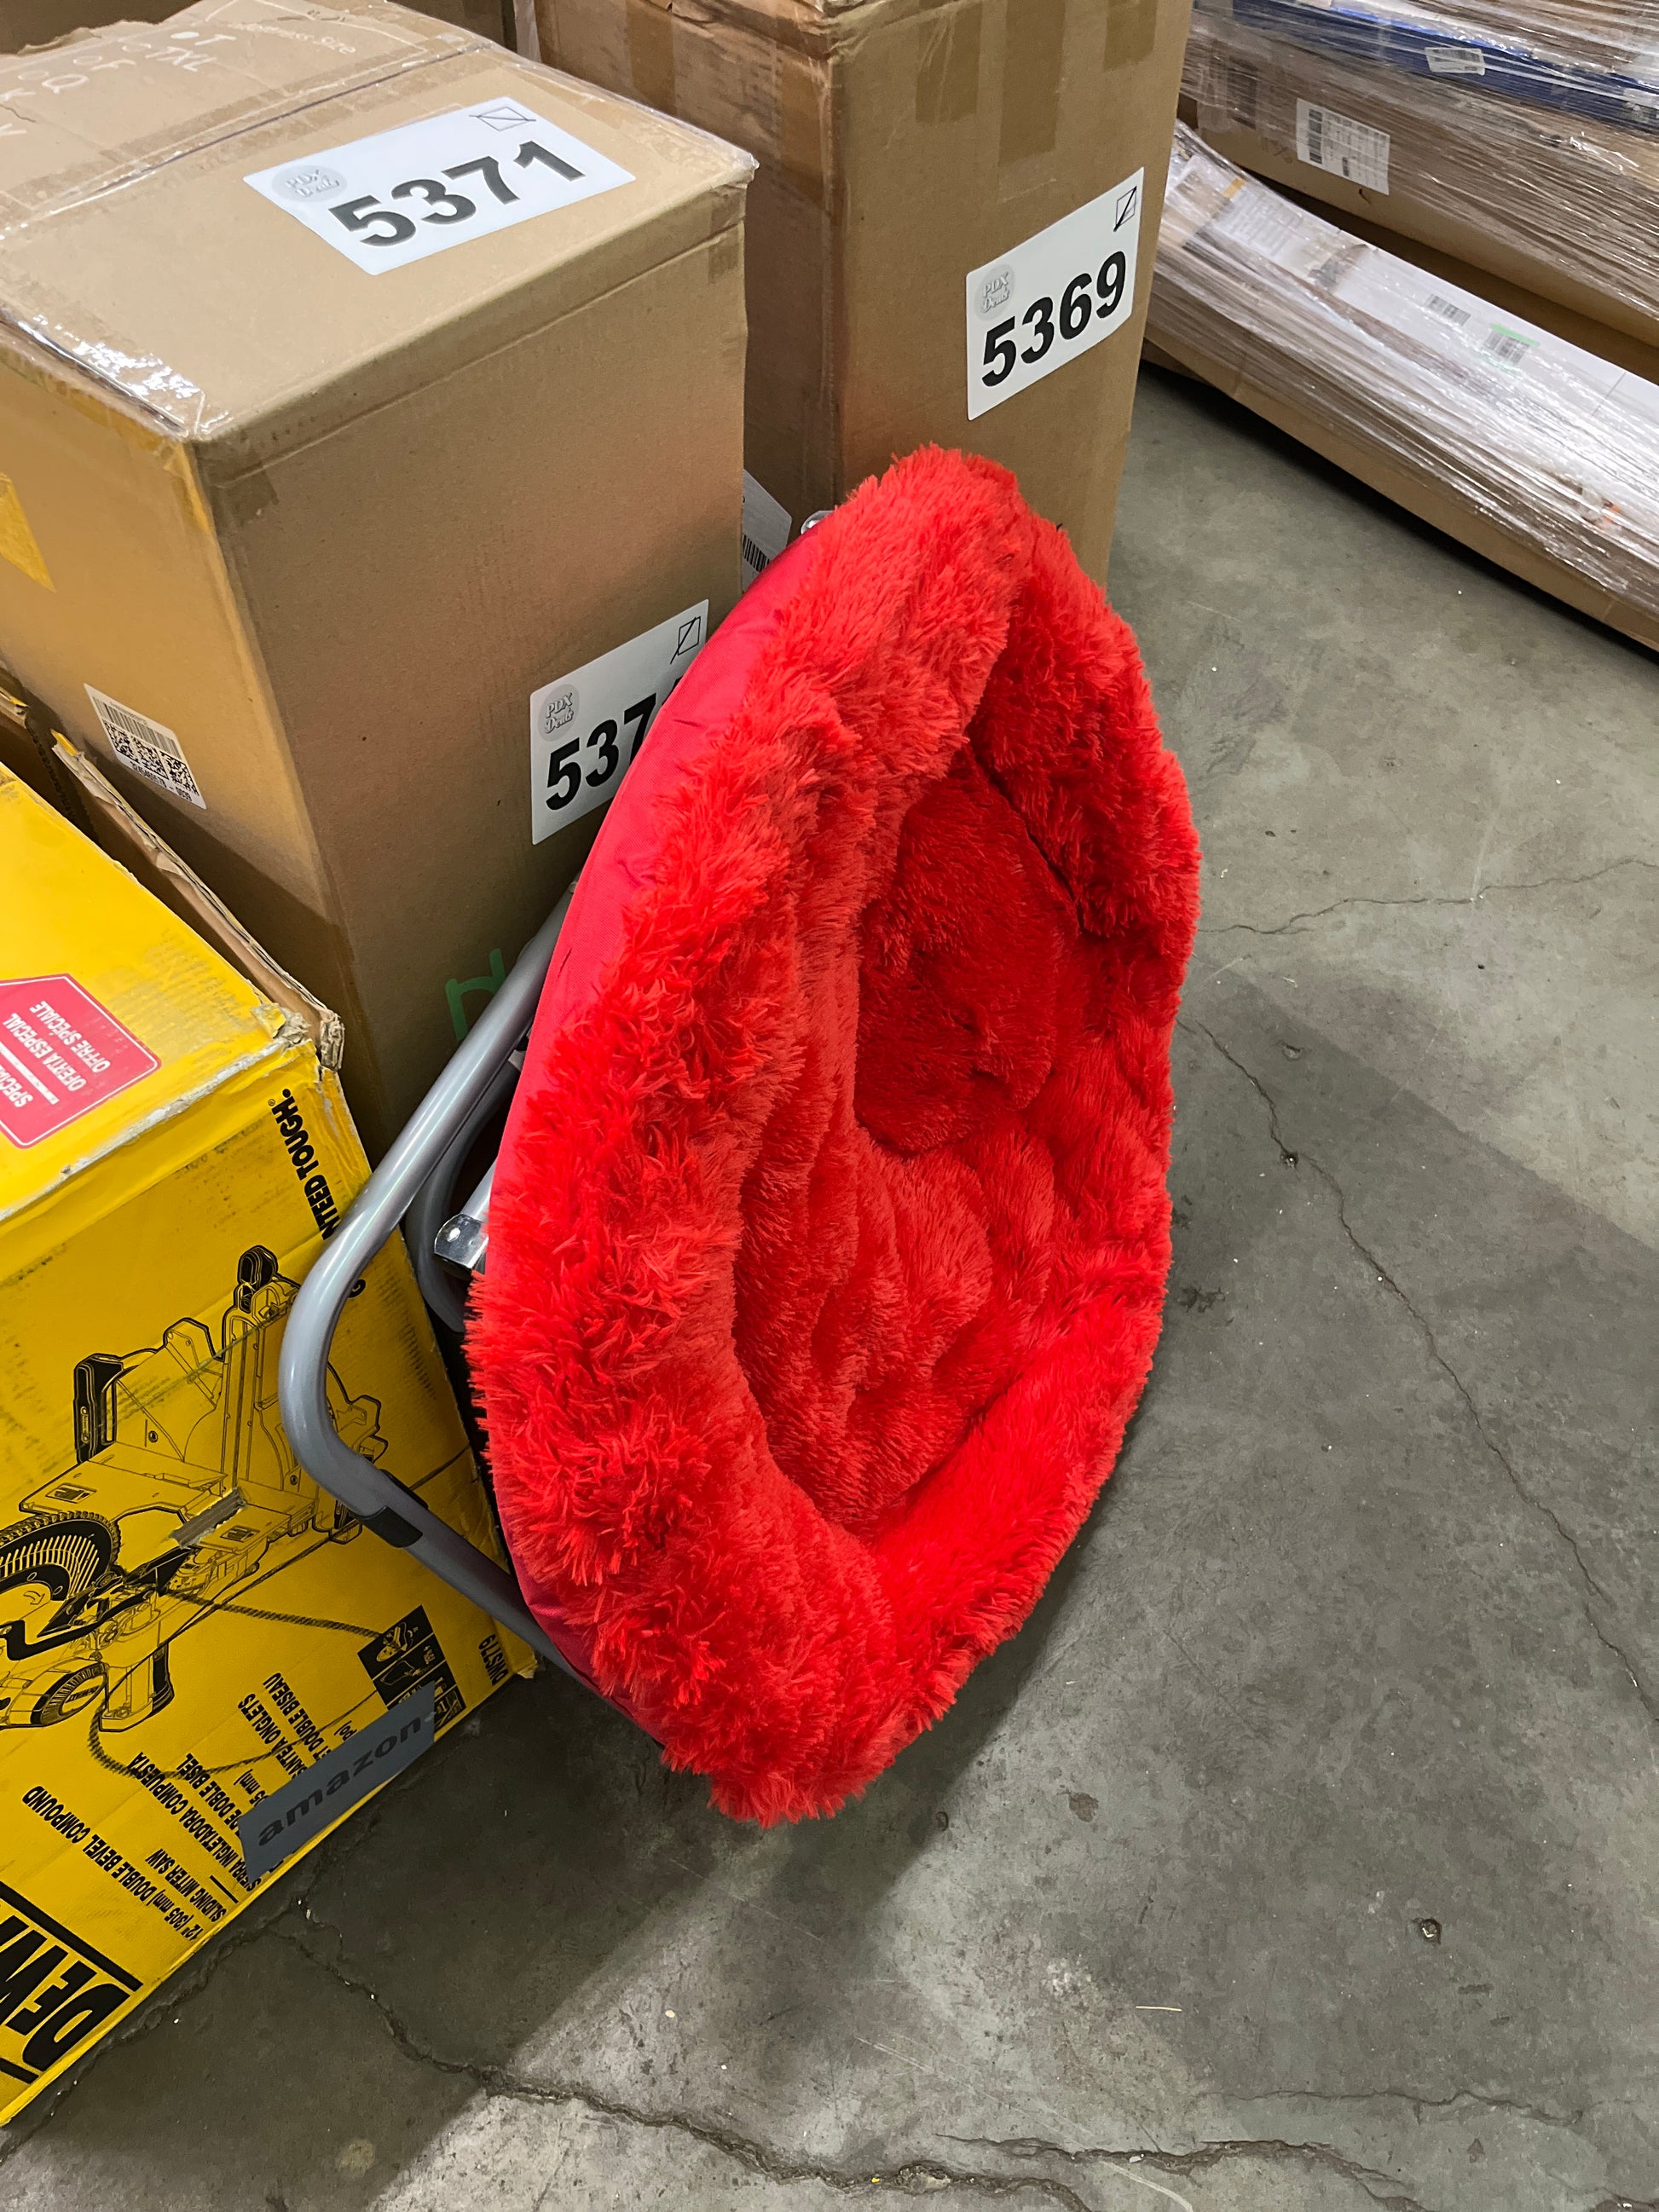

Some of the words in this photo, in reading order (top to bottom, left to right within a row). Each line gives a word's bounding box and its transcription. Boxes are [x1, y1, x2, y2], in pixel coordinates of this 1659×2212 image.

[328, 141, 587, 247] 5371
[981, 272, 1009, 298] PDX
[981, 251, 1126, 387] 5369
[545, 691, 573, 719] PDX
[546, 677, 683, 811] 537
[3, 1013, 54, 1059] ESPECIAL
[70, 1039, 112, 1074] OFFRE
[42, 1052, 88, 1092] OFERTA
[477, 1632, 510, 1687] DWS779
[262, 1671, 302, 1718] BISEAU
[237, 1692, 282, 1746] ONGLETS
[287, 1707, 326, 1753] DOUBLE
[126, 1750, 189, 1816] COMPUESTA
[176, 1752, 211, 1791] BISEL
[258, 1715, 422, 1847] amazon
[20, 1784, 92, 1845] COMPOUND
[197, 1779, 236, 1819] DOBLE
[81, 1833, 124, 1873] BEVEL
[177, 1805, 240, 1868] INGLETADORA
[110, 1861, 159, 1903] DOUBLE
[144, 1847, 176, 1875] SAW
[163, 1863, 200, 1898] MITER
[188, 1886, 228, 1924] SLIDING
[0, 1915, 131, 2071] DEW
